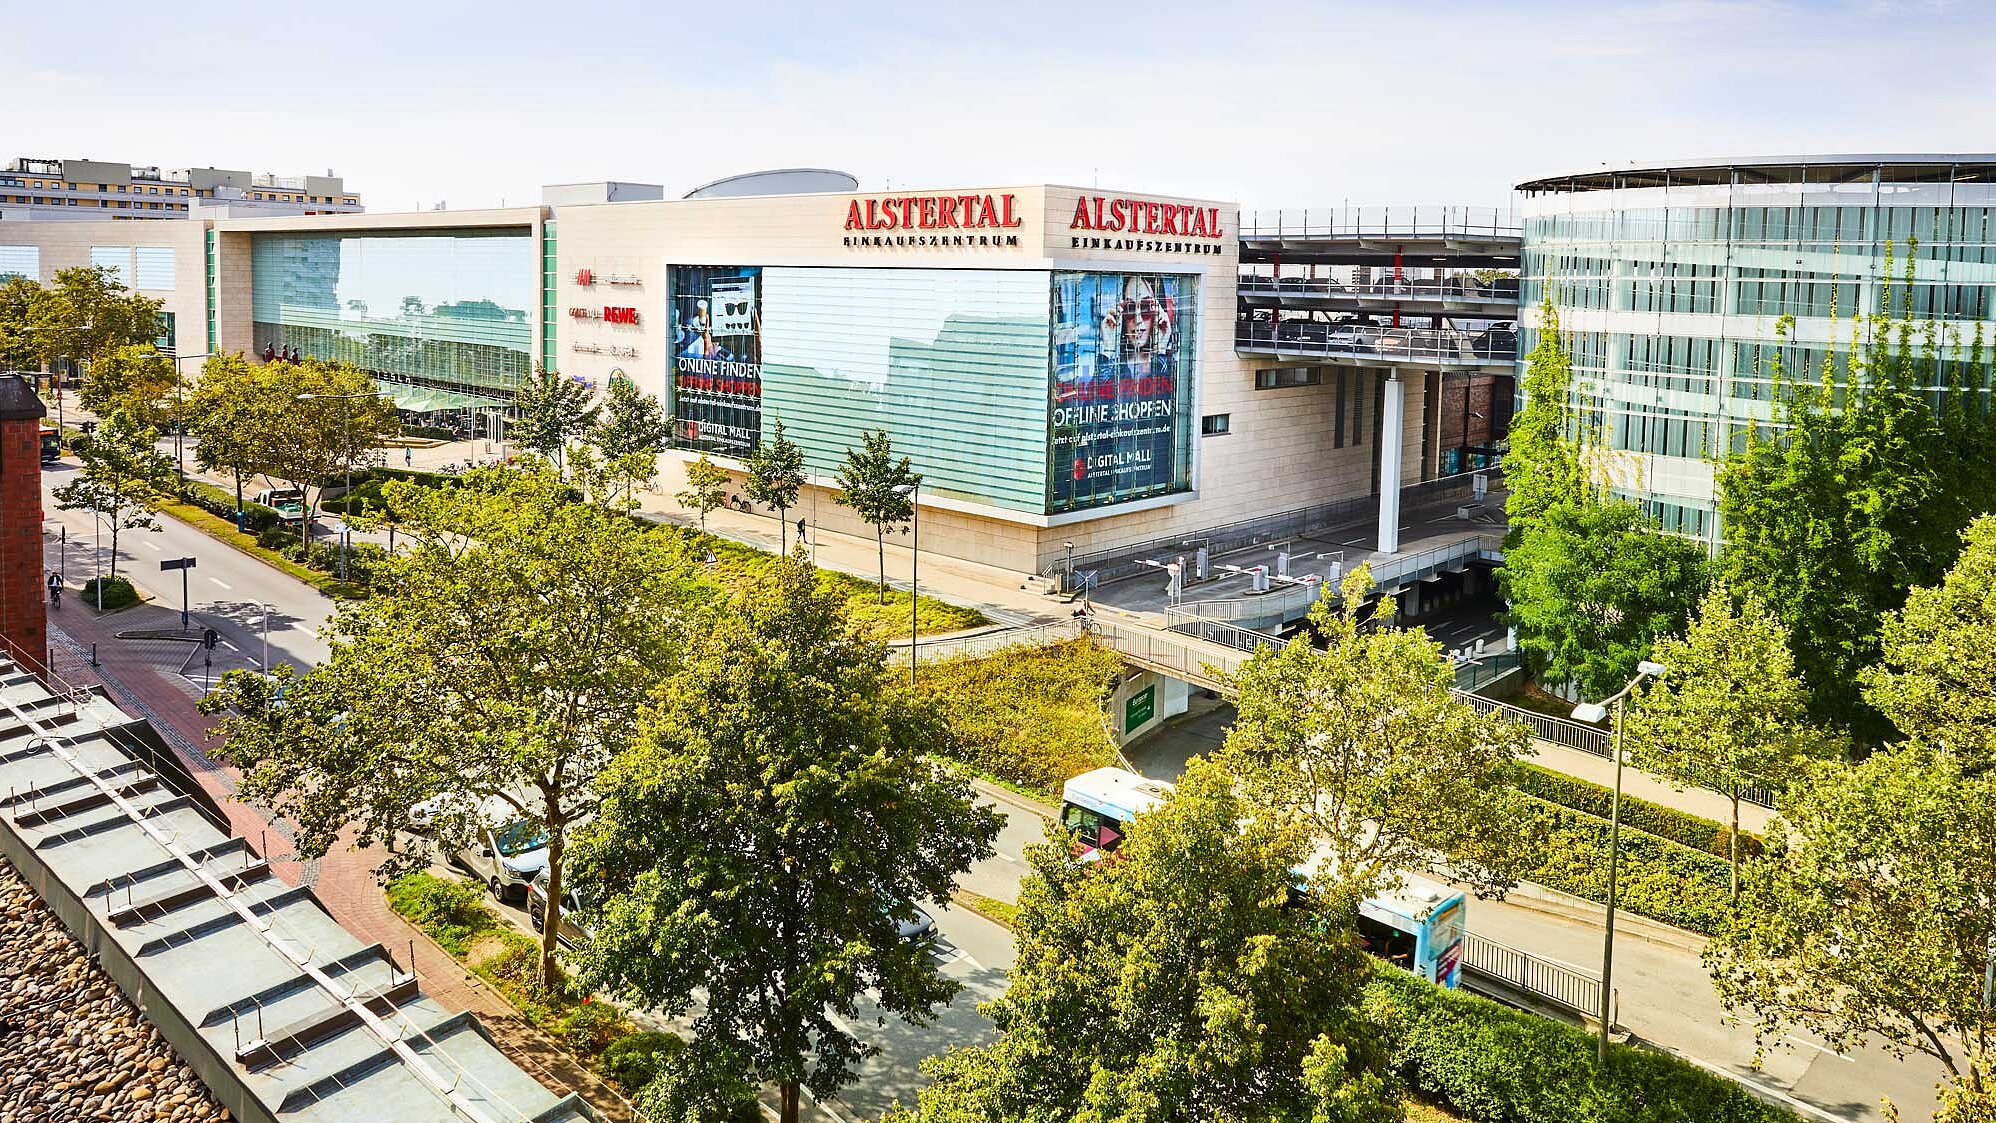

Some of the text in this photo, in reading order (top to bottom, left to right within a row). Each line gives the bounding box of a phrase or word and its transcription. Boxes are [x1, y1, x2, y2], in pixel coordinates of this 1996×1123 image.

[844, 194, 1021, 230] ALSTERTAL
[1070, 195, 1223, 238] ALSTERTAL
[843, 235, 1018, 247] EINKAUFSZENTRUM
[1071, 237, 1222, 255] EINKAUFSZENTRUM
[604, 306, 637, 324] REWE
[679, 358, 762, 379] ONLINE FINDEN
[715, 378, 762, 397] SHOPPEN
[1119, 376, 1172, 397] FINDEN
[1054, 400, 1171, 427] OFFLINE SHOPPEN
[698, 421, 751, 439] DIGITAL MALL
[1087, 449, 1152, 470] DIGITAL MALL
